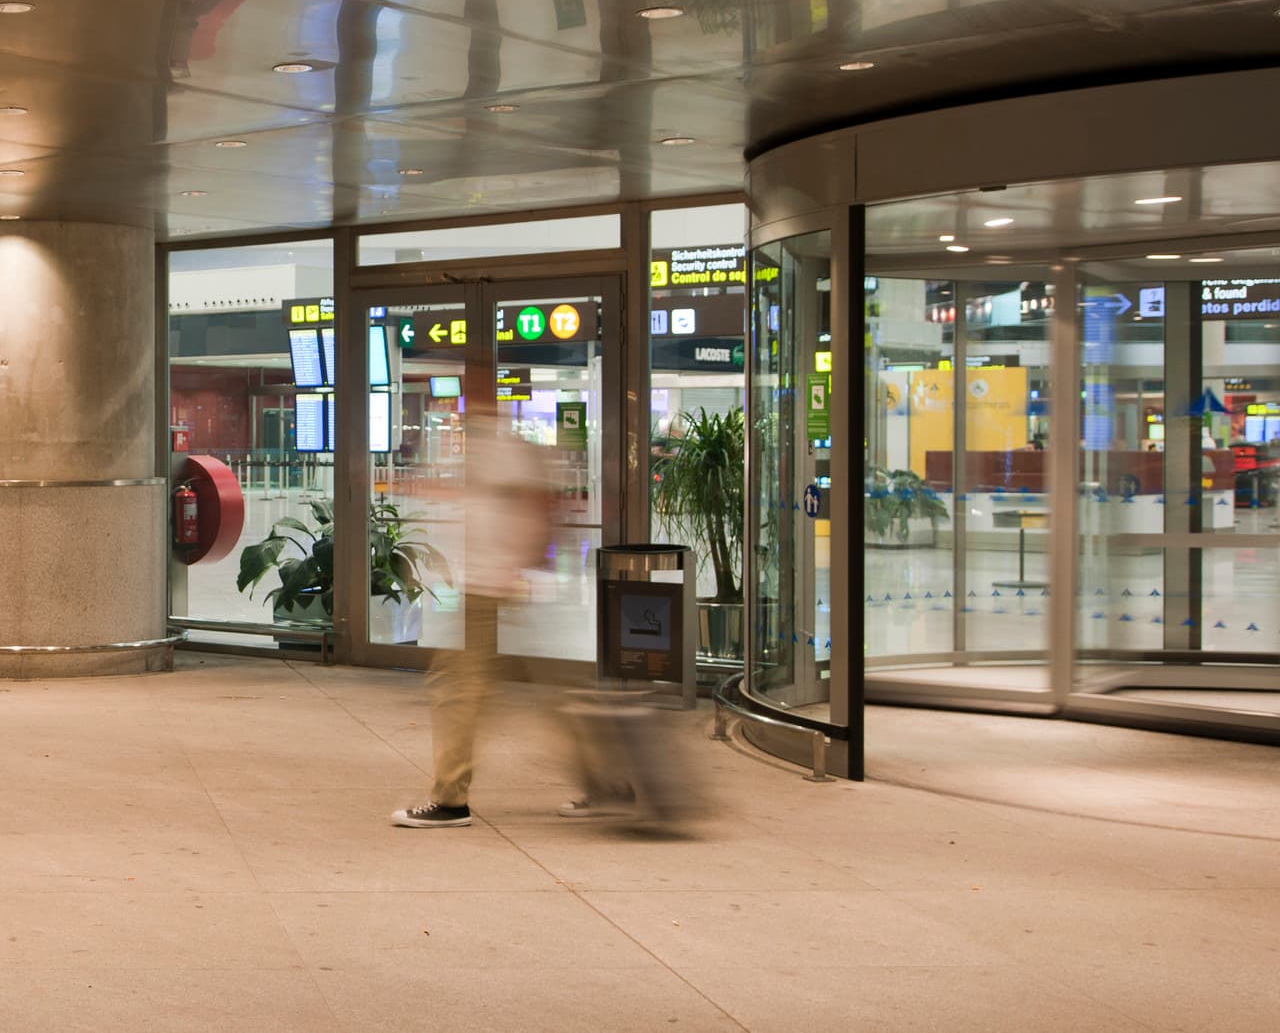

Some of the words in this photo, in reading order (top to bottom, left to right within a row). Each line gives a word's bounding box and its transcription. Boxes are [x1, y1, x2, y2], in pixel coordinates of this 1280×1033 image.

[671, 260, 706, 272] Security
[707, 257, 737, 270] control
[671, 269, 711, 284] Control
[712, 269, 727, 282] de
[1214, 285, 1248, 300] found
[519, 313, 542, 333] T1
[552, 312, 577, 332] T2
[695, 348, 731, 363] LACOSTE
